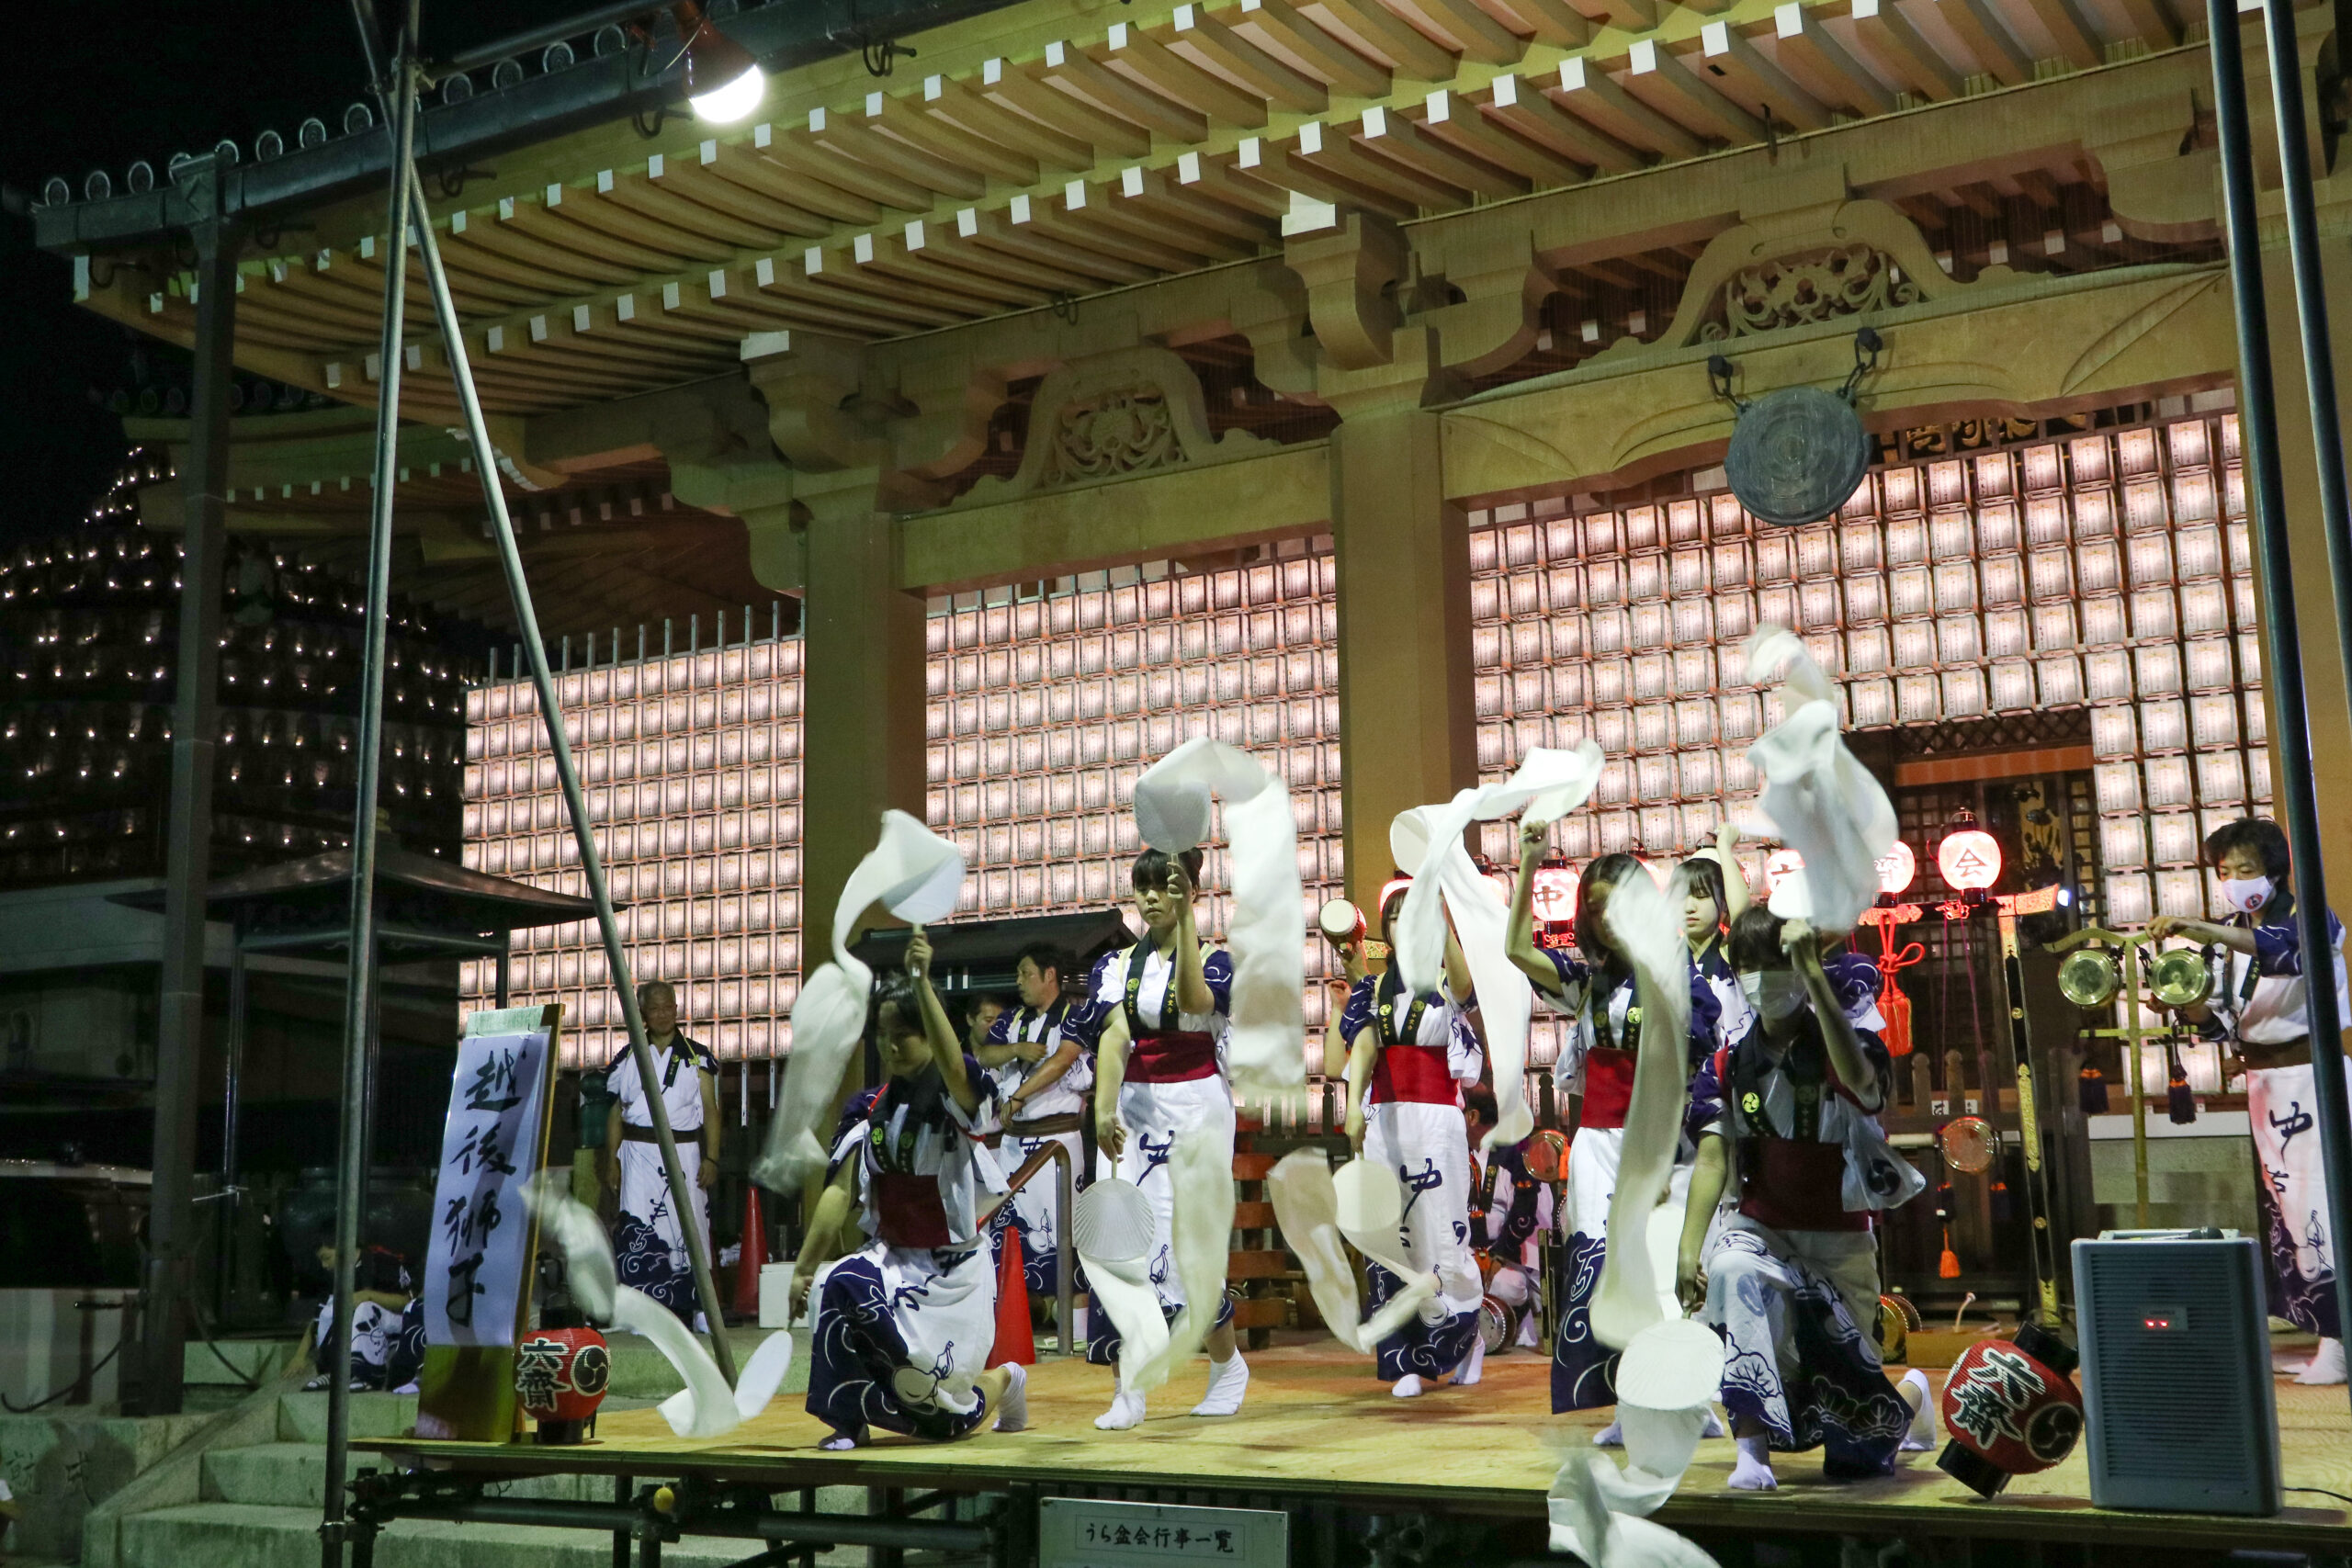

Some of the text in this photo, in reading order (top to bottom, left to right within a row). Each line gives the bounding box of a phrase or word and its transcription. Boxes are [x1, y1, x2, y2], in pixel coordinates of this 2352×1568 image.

[1954, 847, 1987, 879] 会
[1532, 885, 1564, 916] 中
[445, 1048, 526, 1328] 越後獅子
[1085, 1522, 1235, 1554] うら盆会行事一覧
